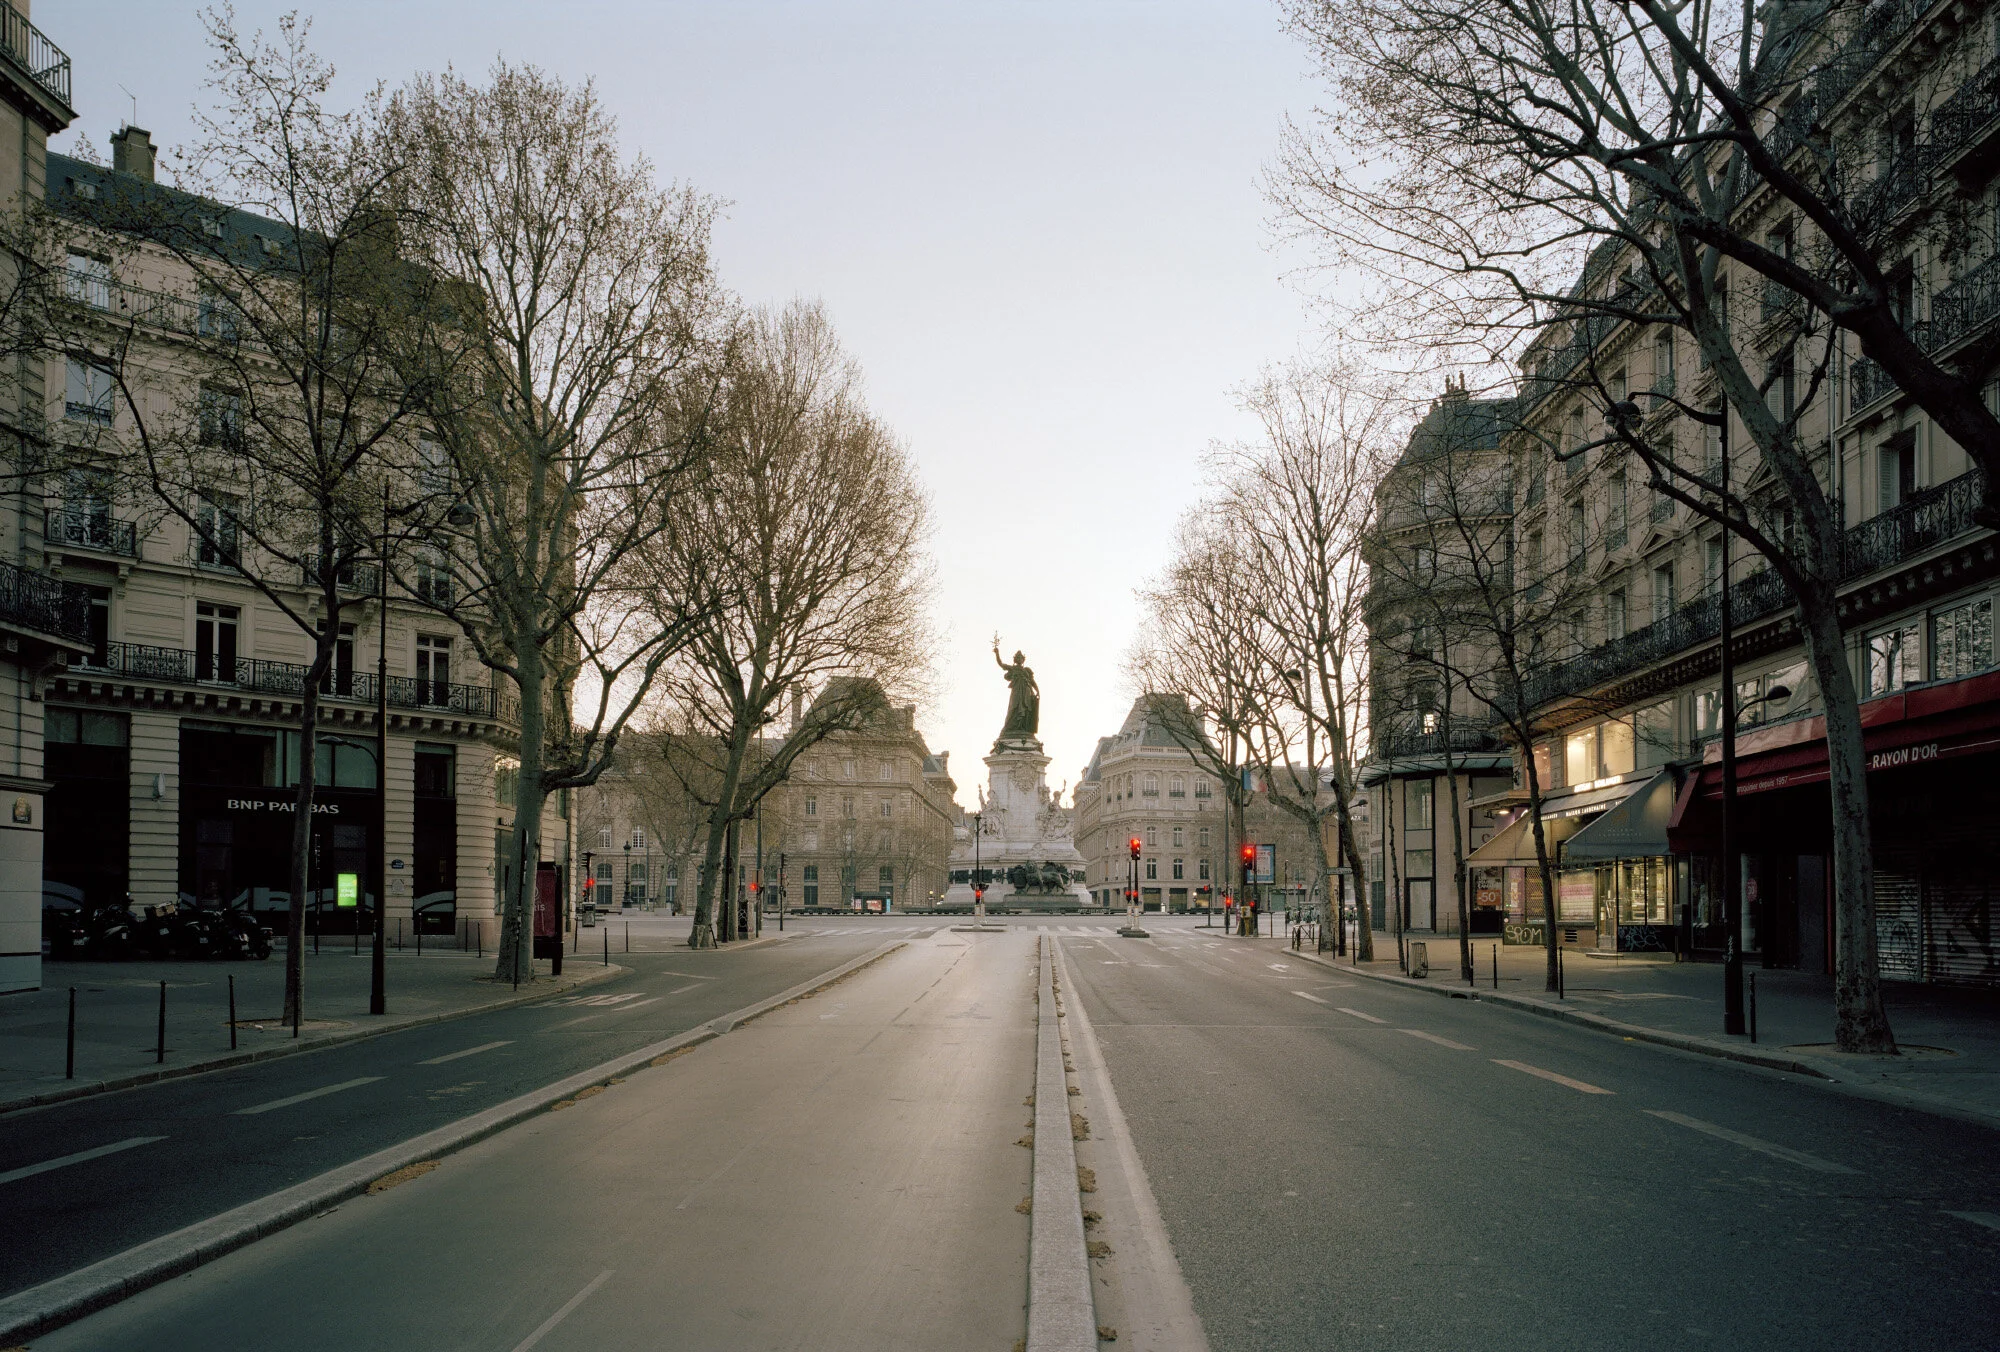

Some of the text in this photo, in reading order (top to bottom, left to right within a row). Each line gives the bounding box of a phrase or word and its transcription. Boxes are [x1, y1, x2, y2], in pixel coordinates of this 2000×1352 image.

[1872, 743, 1938, 769] RAYON D'OR
[227, 799, 265, 811] BNP
